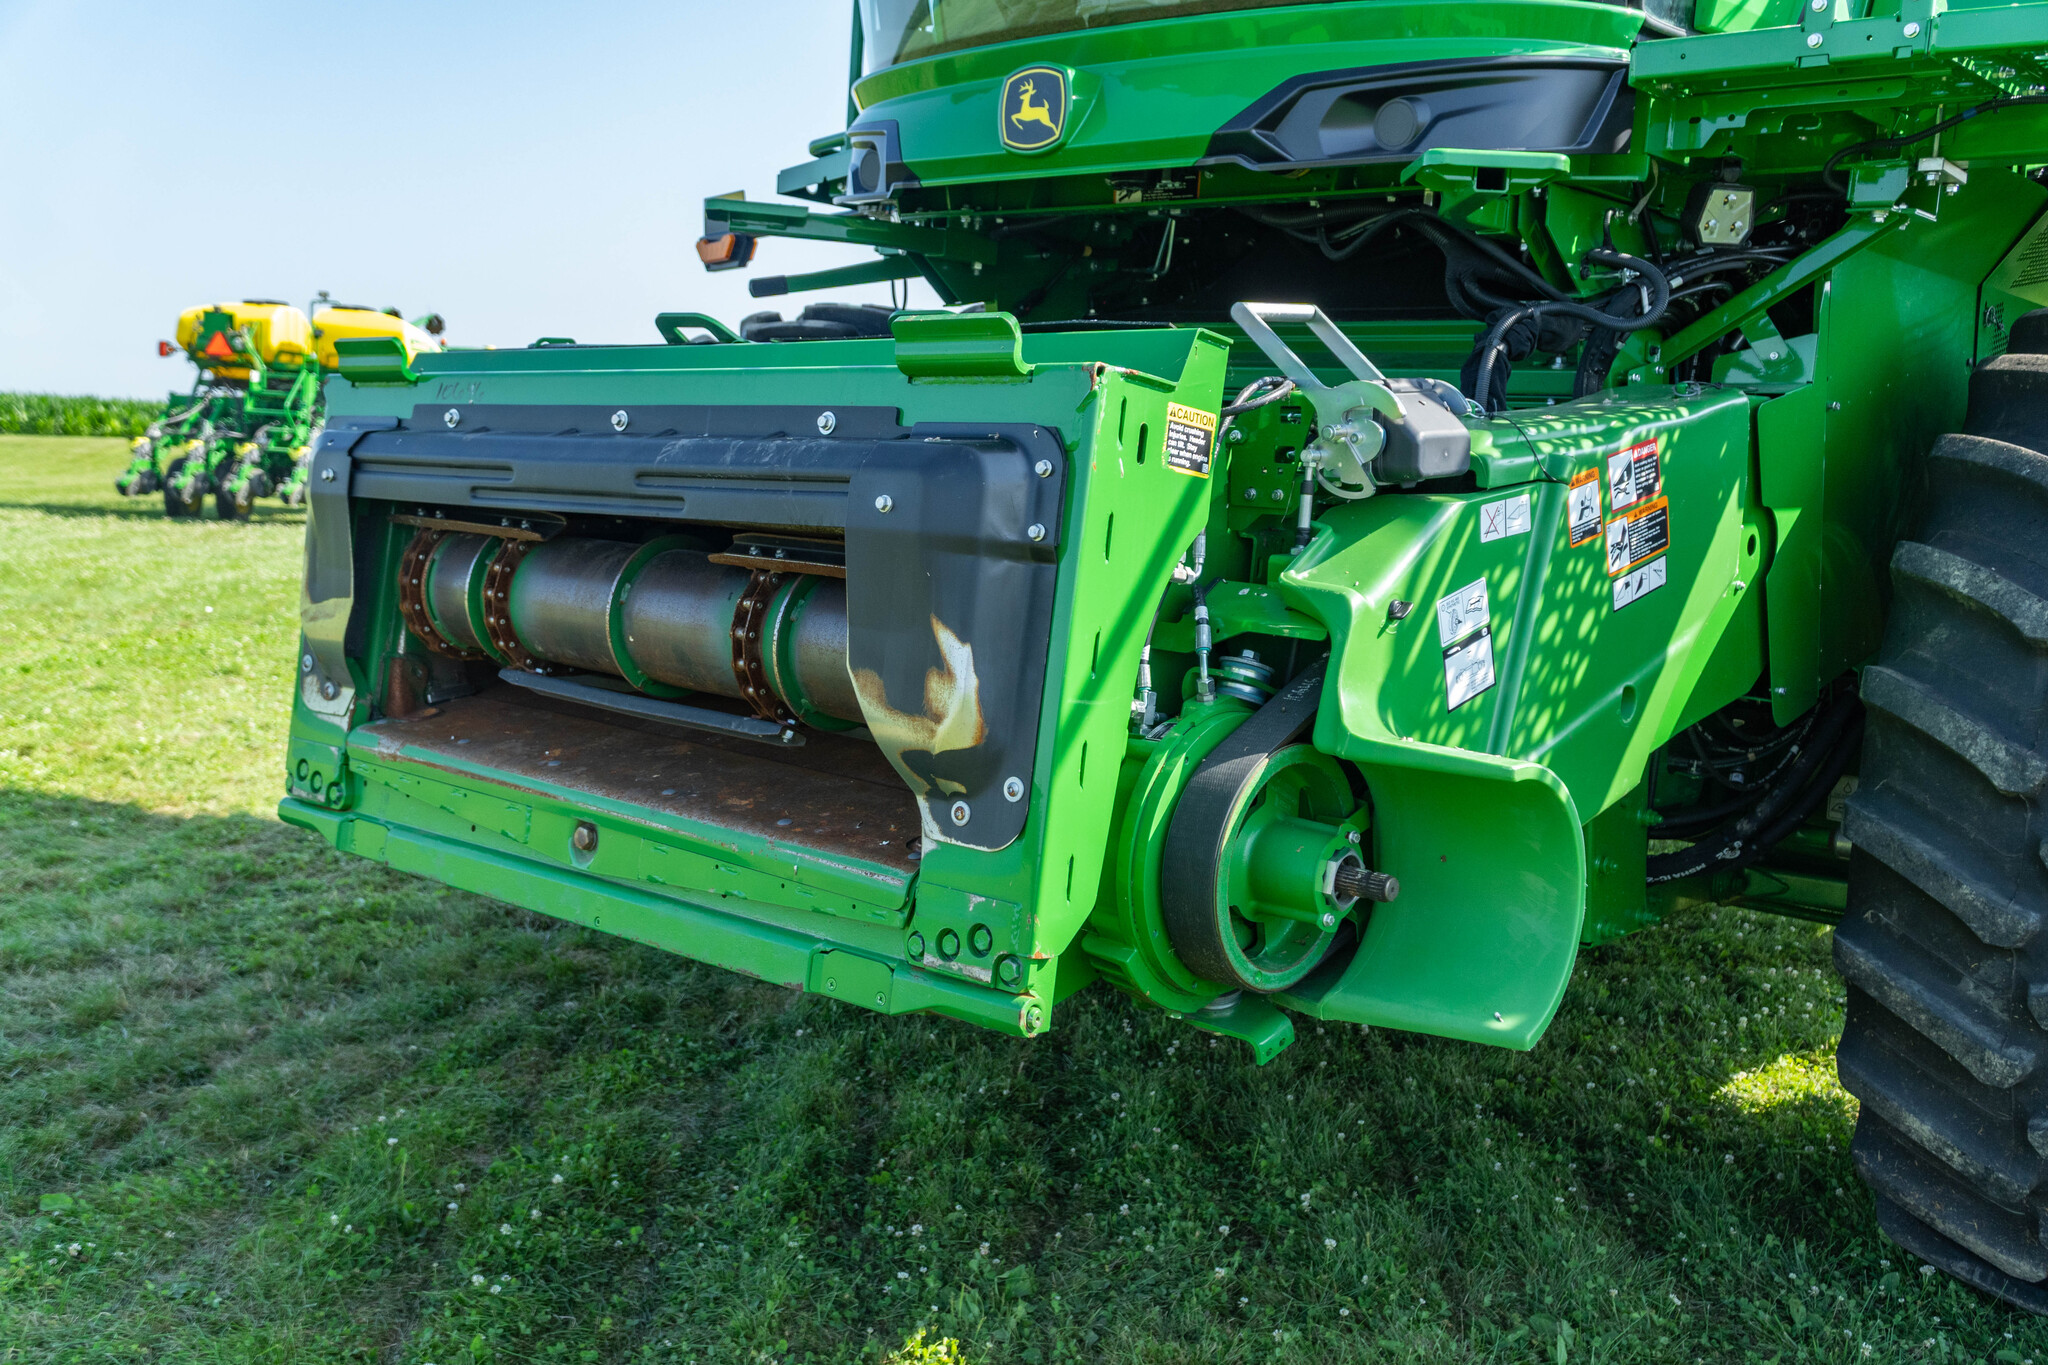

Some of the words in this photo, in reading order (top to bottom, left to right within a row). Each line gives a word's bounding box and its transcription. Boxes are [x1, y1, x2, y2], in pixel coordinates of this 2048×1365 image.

[1177, 408, 1214, 427] CAUTION
[1170, 422, 1184, 432] Avoid
[1184, 427, 1205, 438] crushing
[1187, 443, 1198, 453] Stay
[1638, 442, 1657, 457] DANGER
[1179, 450, 1192, 458] when
[1192, 453, 1208, 462] engine
[1638, 502, 1658, 515] WARNING
